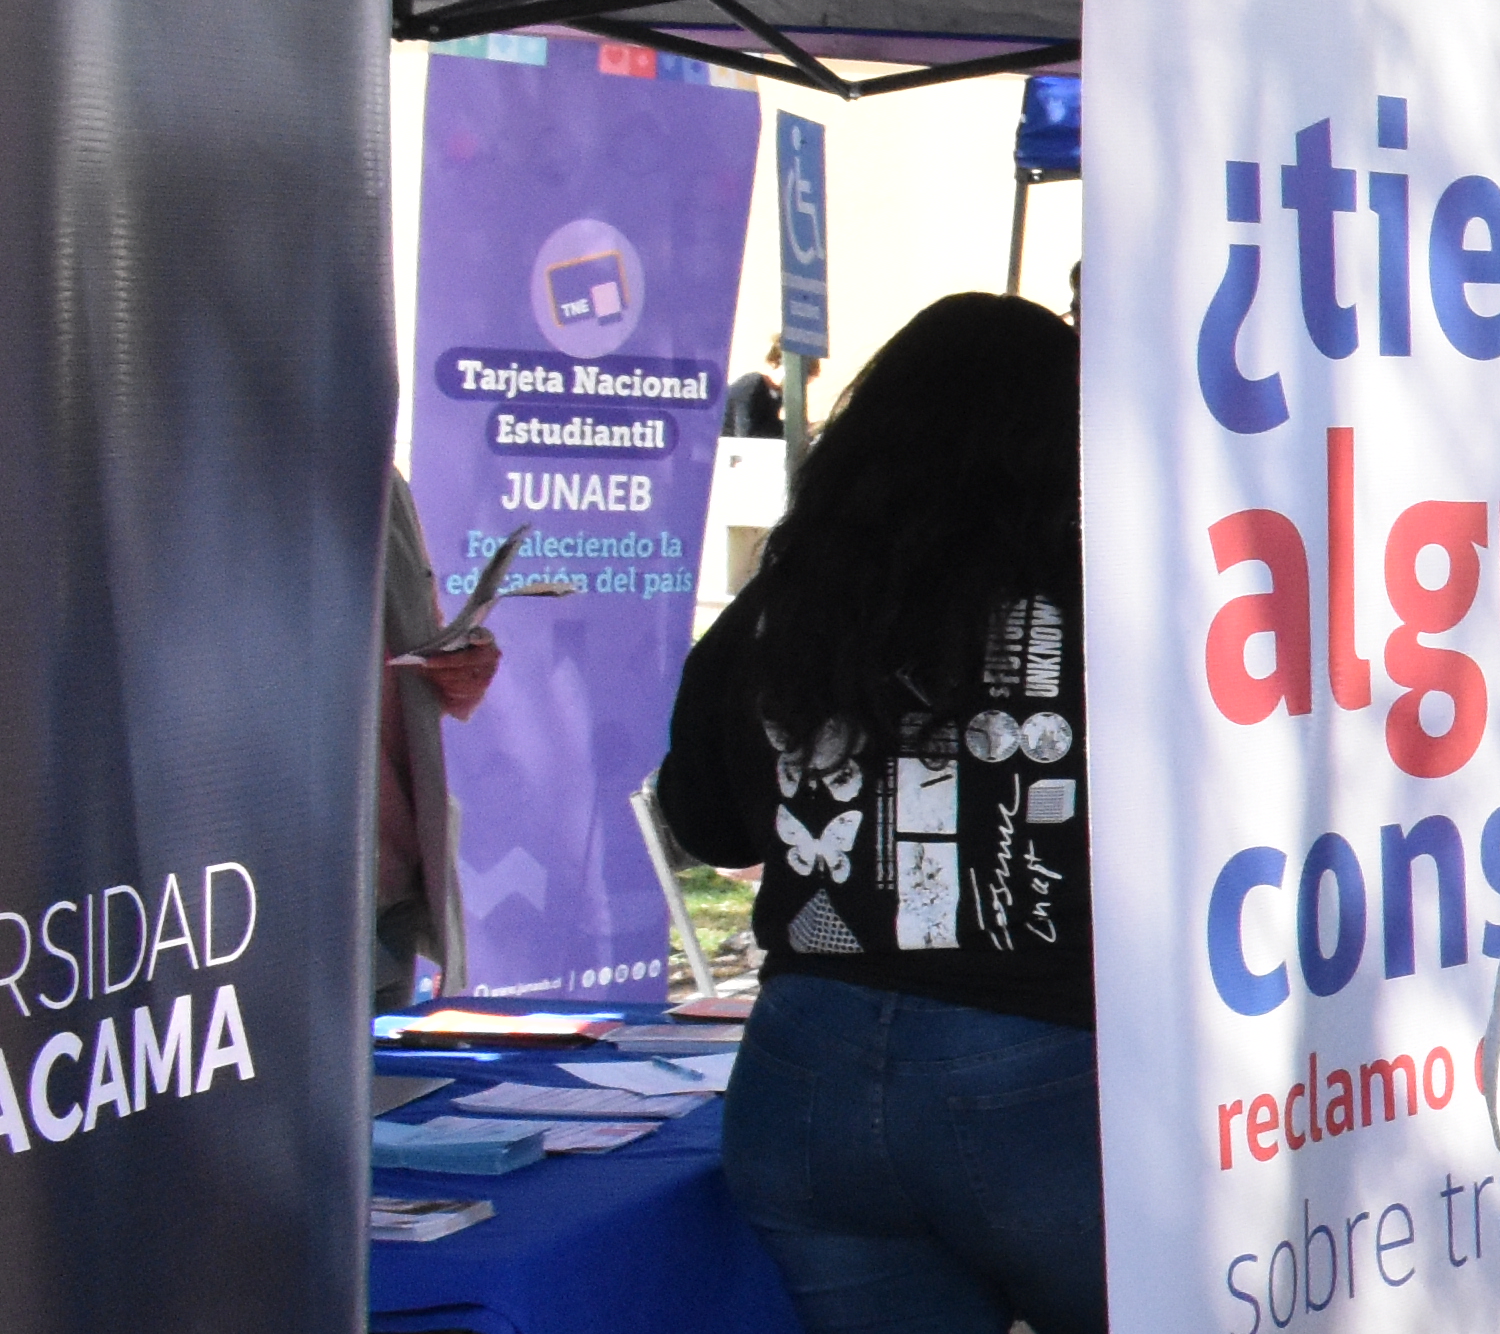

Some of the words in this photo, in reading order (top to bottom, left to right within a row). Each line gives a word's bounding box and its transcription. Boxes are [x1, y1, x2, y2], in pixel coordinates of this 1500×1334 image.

[561, 298, 590, 317] TNE
[458, 360, 564, 398] Tarjeta
[572, 366, 708, 399] Nacional
[496, 415, 665, 448] Estudiantil
[502, 472, 652, 511] JUNAEB
[660, 531, 682, 557] la
[447, 567, 588, 594] edcación
[596, 567, 635, 593] del
[645, 567, 692, 599] país
[1218, 1045, 1454, 1171] reclamo
